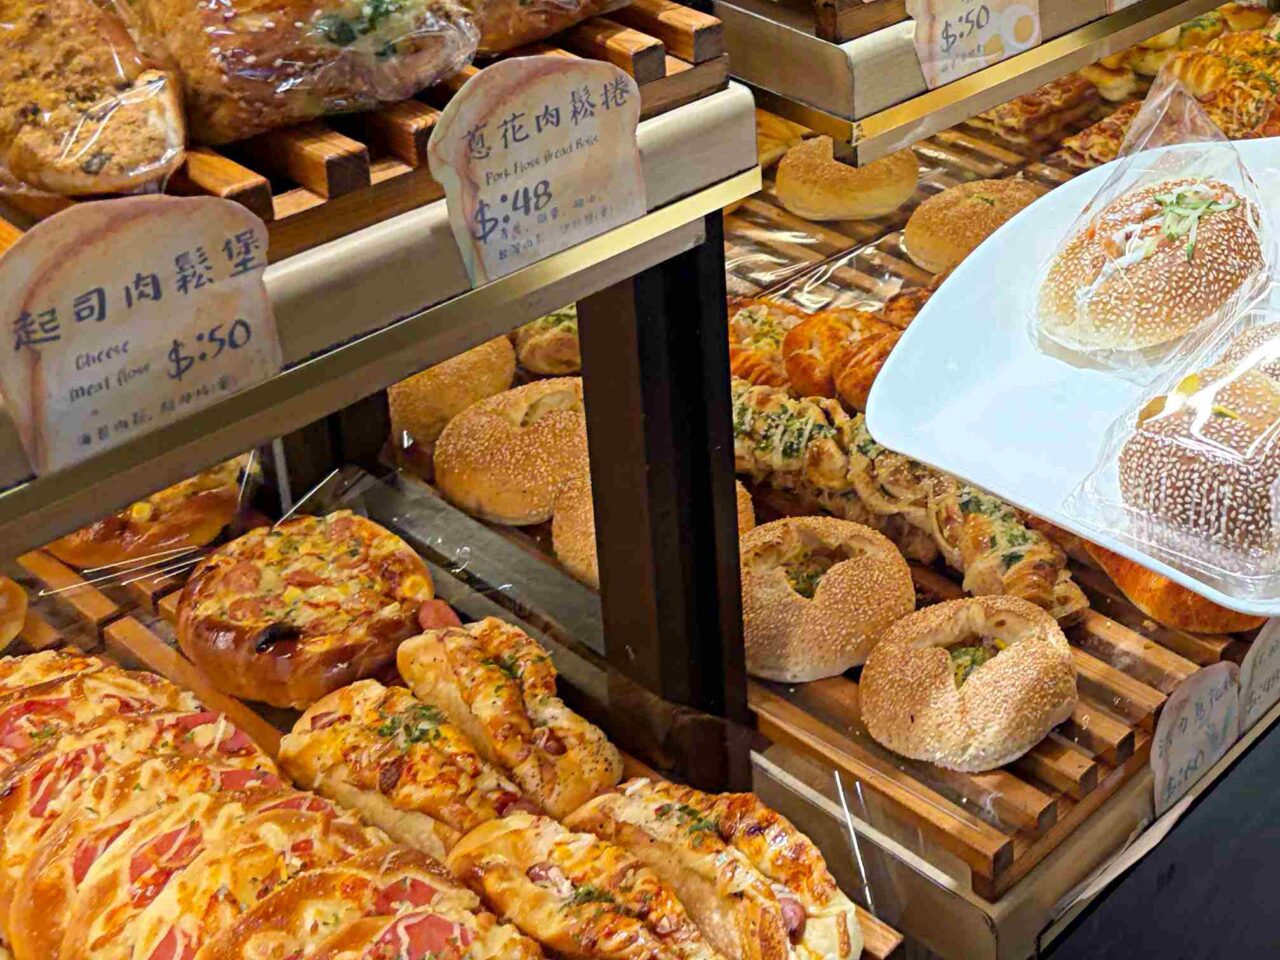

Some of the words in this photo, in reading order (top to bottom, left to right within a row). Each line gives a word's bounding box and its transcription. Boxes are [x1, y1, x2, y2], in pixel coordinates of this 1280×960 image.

[13, 228, 268, 352] 起司肉鬆堡
